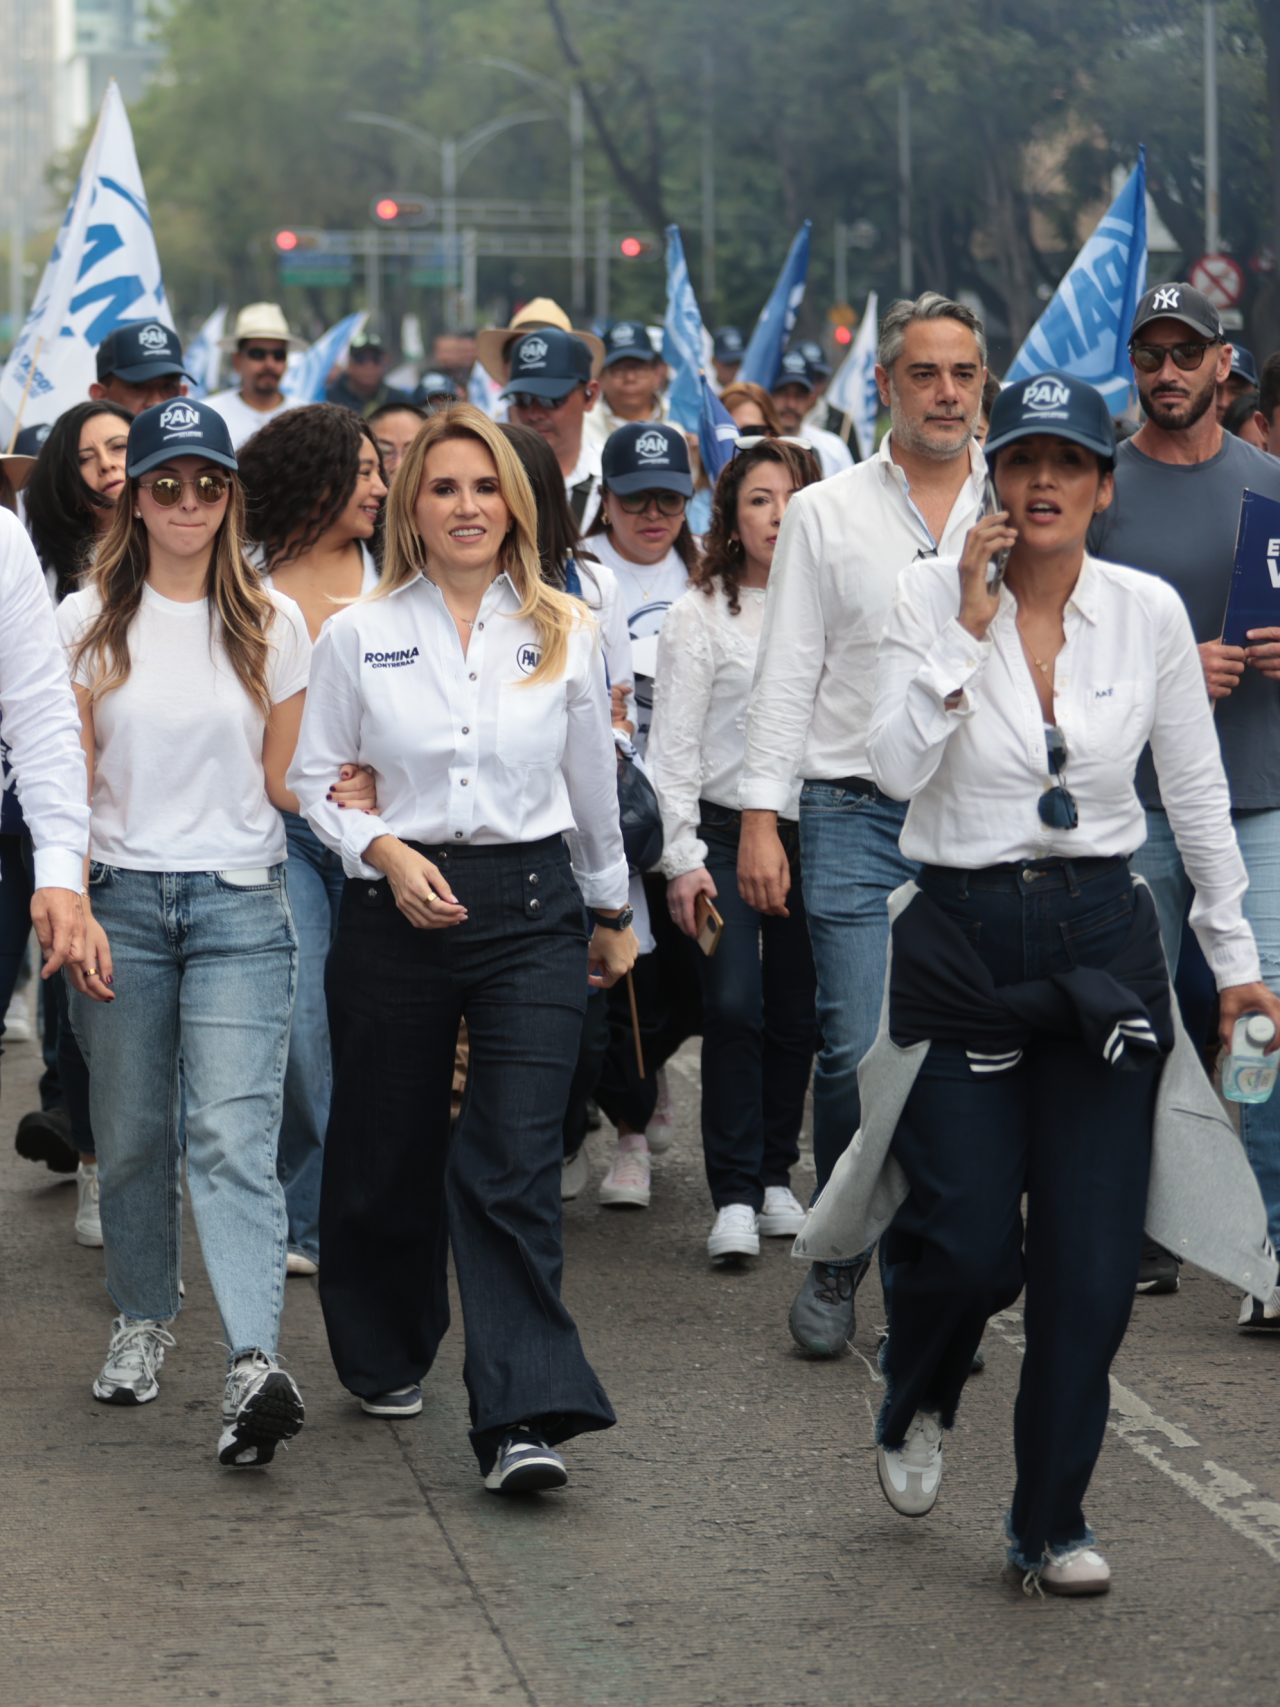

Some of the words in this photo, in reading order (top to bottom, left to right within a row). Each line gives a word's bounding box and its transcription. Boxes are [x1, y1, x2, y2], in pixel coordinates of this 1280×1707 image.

[139, 331, 168, 345] PAN
[520, 343, 548, 358] PAN
[1022, 384, 1070, 404] PAN
[160, 410, 199, 428] PAN
[635, 438, 668, 453] PAN
[364, 647, 419, 663] ROMINA
[372, 659, 415, 669] CONTRERAS
